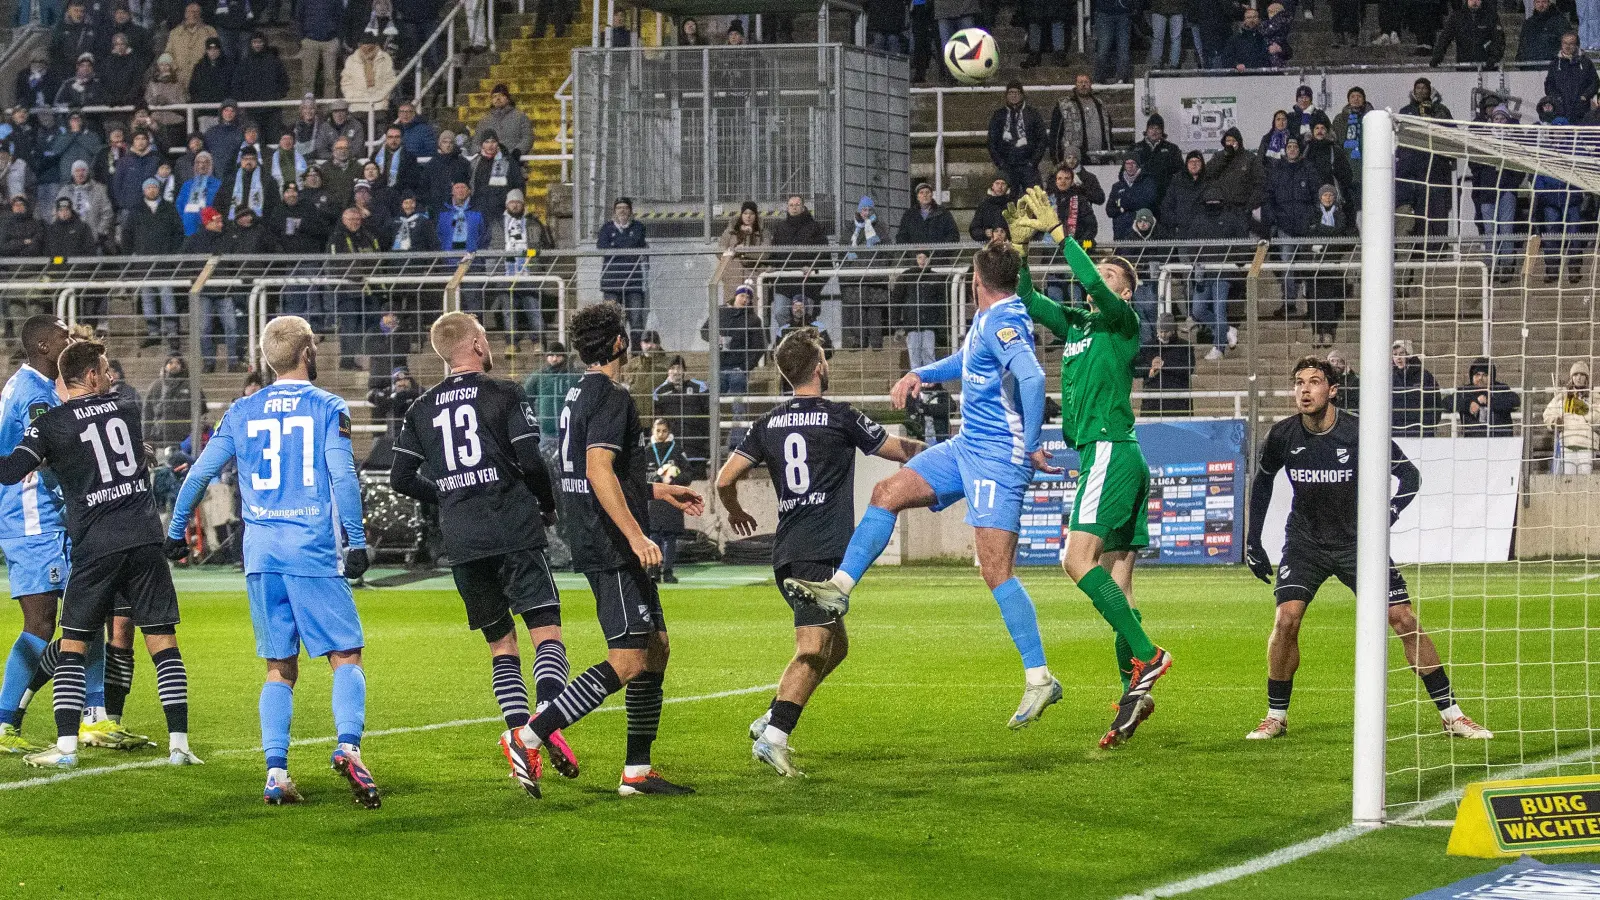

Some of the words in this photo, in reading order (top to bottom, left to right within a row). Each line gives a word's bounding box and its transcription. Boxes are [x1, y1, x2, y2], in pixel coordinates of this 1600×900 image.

[263, 397, 301, 414] FREY
[435, 386, 478, 406] LOKOTSCH
[73, 401, 118, 420] KIJEWSKI
[432, 404, 482, 471] 13
[79, 417, 138, 484] 19
[247, 416, 315, 491] 37
[784, 432, 810, 495] 8
[1208, 462, 1233, 472] REWE
[477, 466, 499, 484] VERL
[1060, 481, 1077, 489] LIGA
[1158, 477, 1176, 485] LIGA
[1289, 468, 1353, 483] BECKHOFF
[86, 482, 133, 507] SPORTCLUB
[973, 479, 997, 509] 17
[1206, 535, 1231, 544] REWE
[1520, 794, 1588, 815] BURG
[1503, 815, 1600, 840] WÄCHTE
